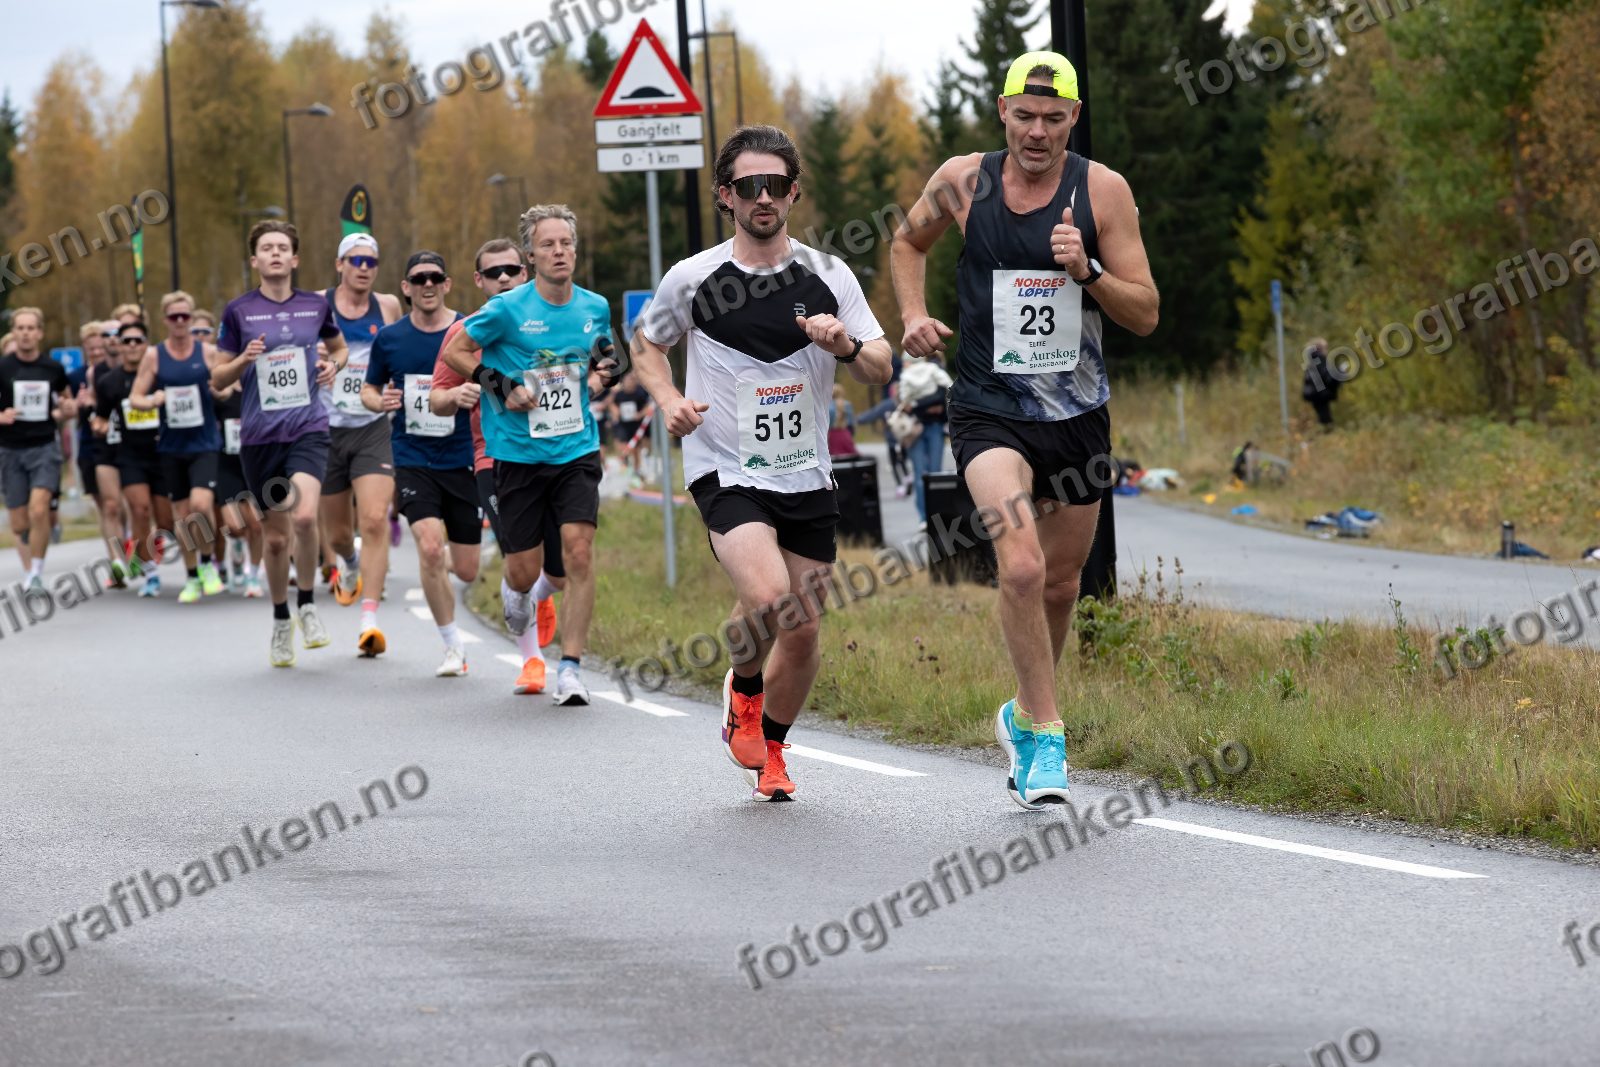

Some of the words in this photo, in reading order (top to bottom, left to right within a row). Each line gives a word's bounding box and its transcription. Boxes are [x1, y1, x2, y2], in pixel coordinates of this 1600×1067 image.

[617, 124, 681, 141] Gangfelt
[622, 153, 633, 166] 0
[647, 153, 653, 165] 1
[657, 152, 680, 164] km
[1012, 277, 1067, 288] NORGES
[1018, 288, 1058, 297] LØPET
[1019, 304, 1056, 336] 23
[1029, 348, 1077, 362] Aurskog
[268, 368, 298, 388] 489
[538, 369, 571, 380] NORGES
[343, 377, 362, 394] 88
[755, 383, 804, 397] NORGES
[539, 388, 573, 411] 422
[759, 394, 797, 406] LØPET
[754, 409, 802, 442] 513
[773, 448, 816, 464] Aurskog
